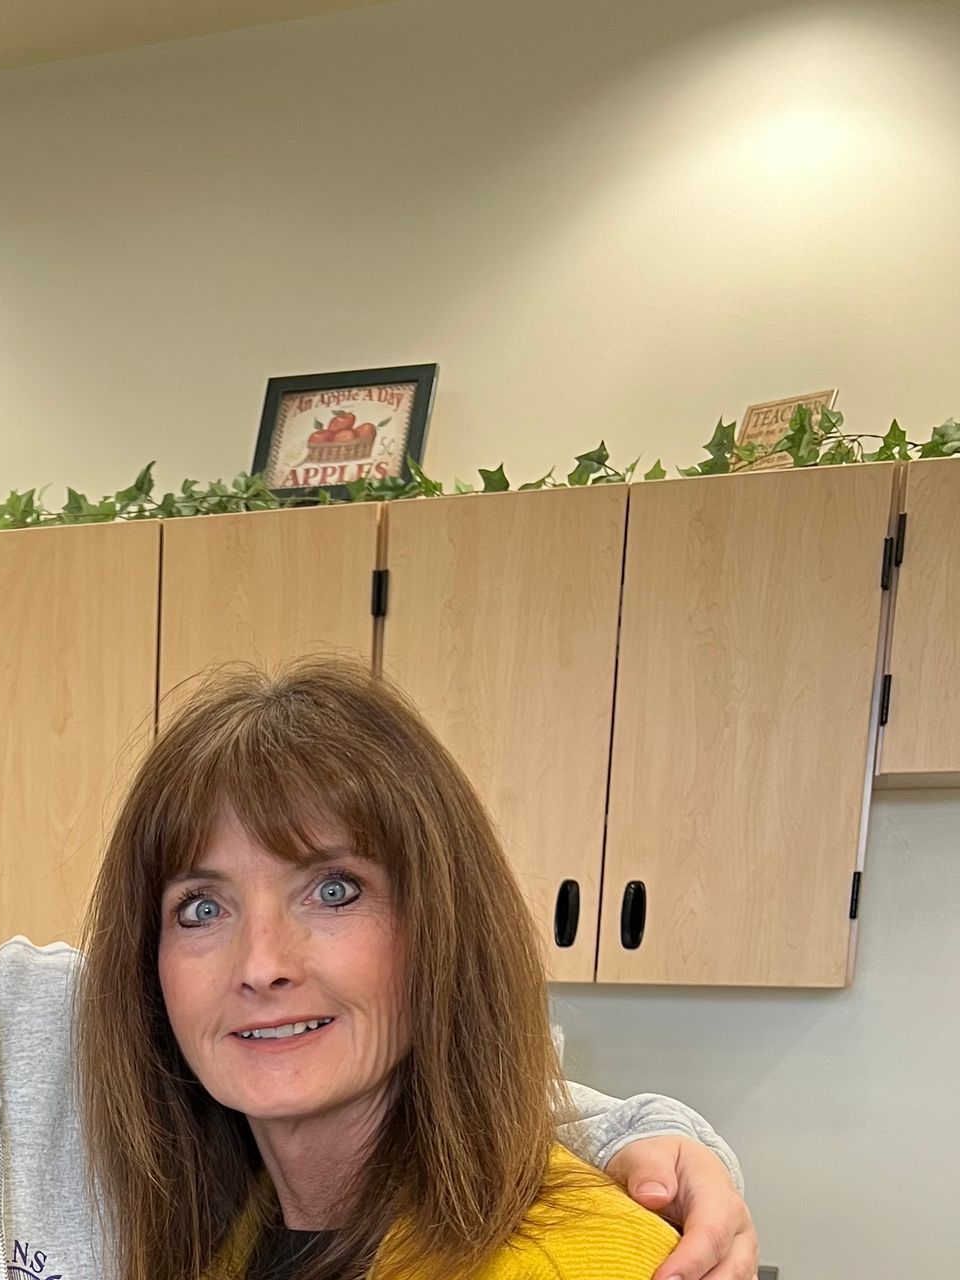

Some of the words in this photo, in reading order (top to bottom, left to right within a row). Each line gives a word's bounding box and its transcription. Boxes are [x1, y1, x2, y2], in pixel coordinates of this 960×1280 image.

[319, 390, 360, 407] Apple
[363, 389, 373, 401] A
[378, 387, 403, 412] Day
[753, 400, 823, 428] TEACR
[281, 461, 389, 488] APPLES
